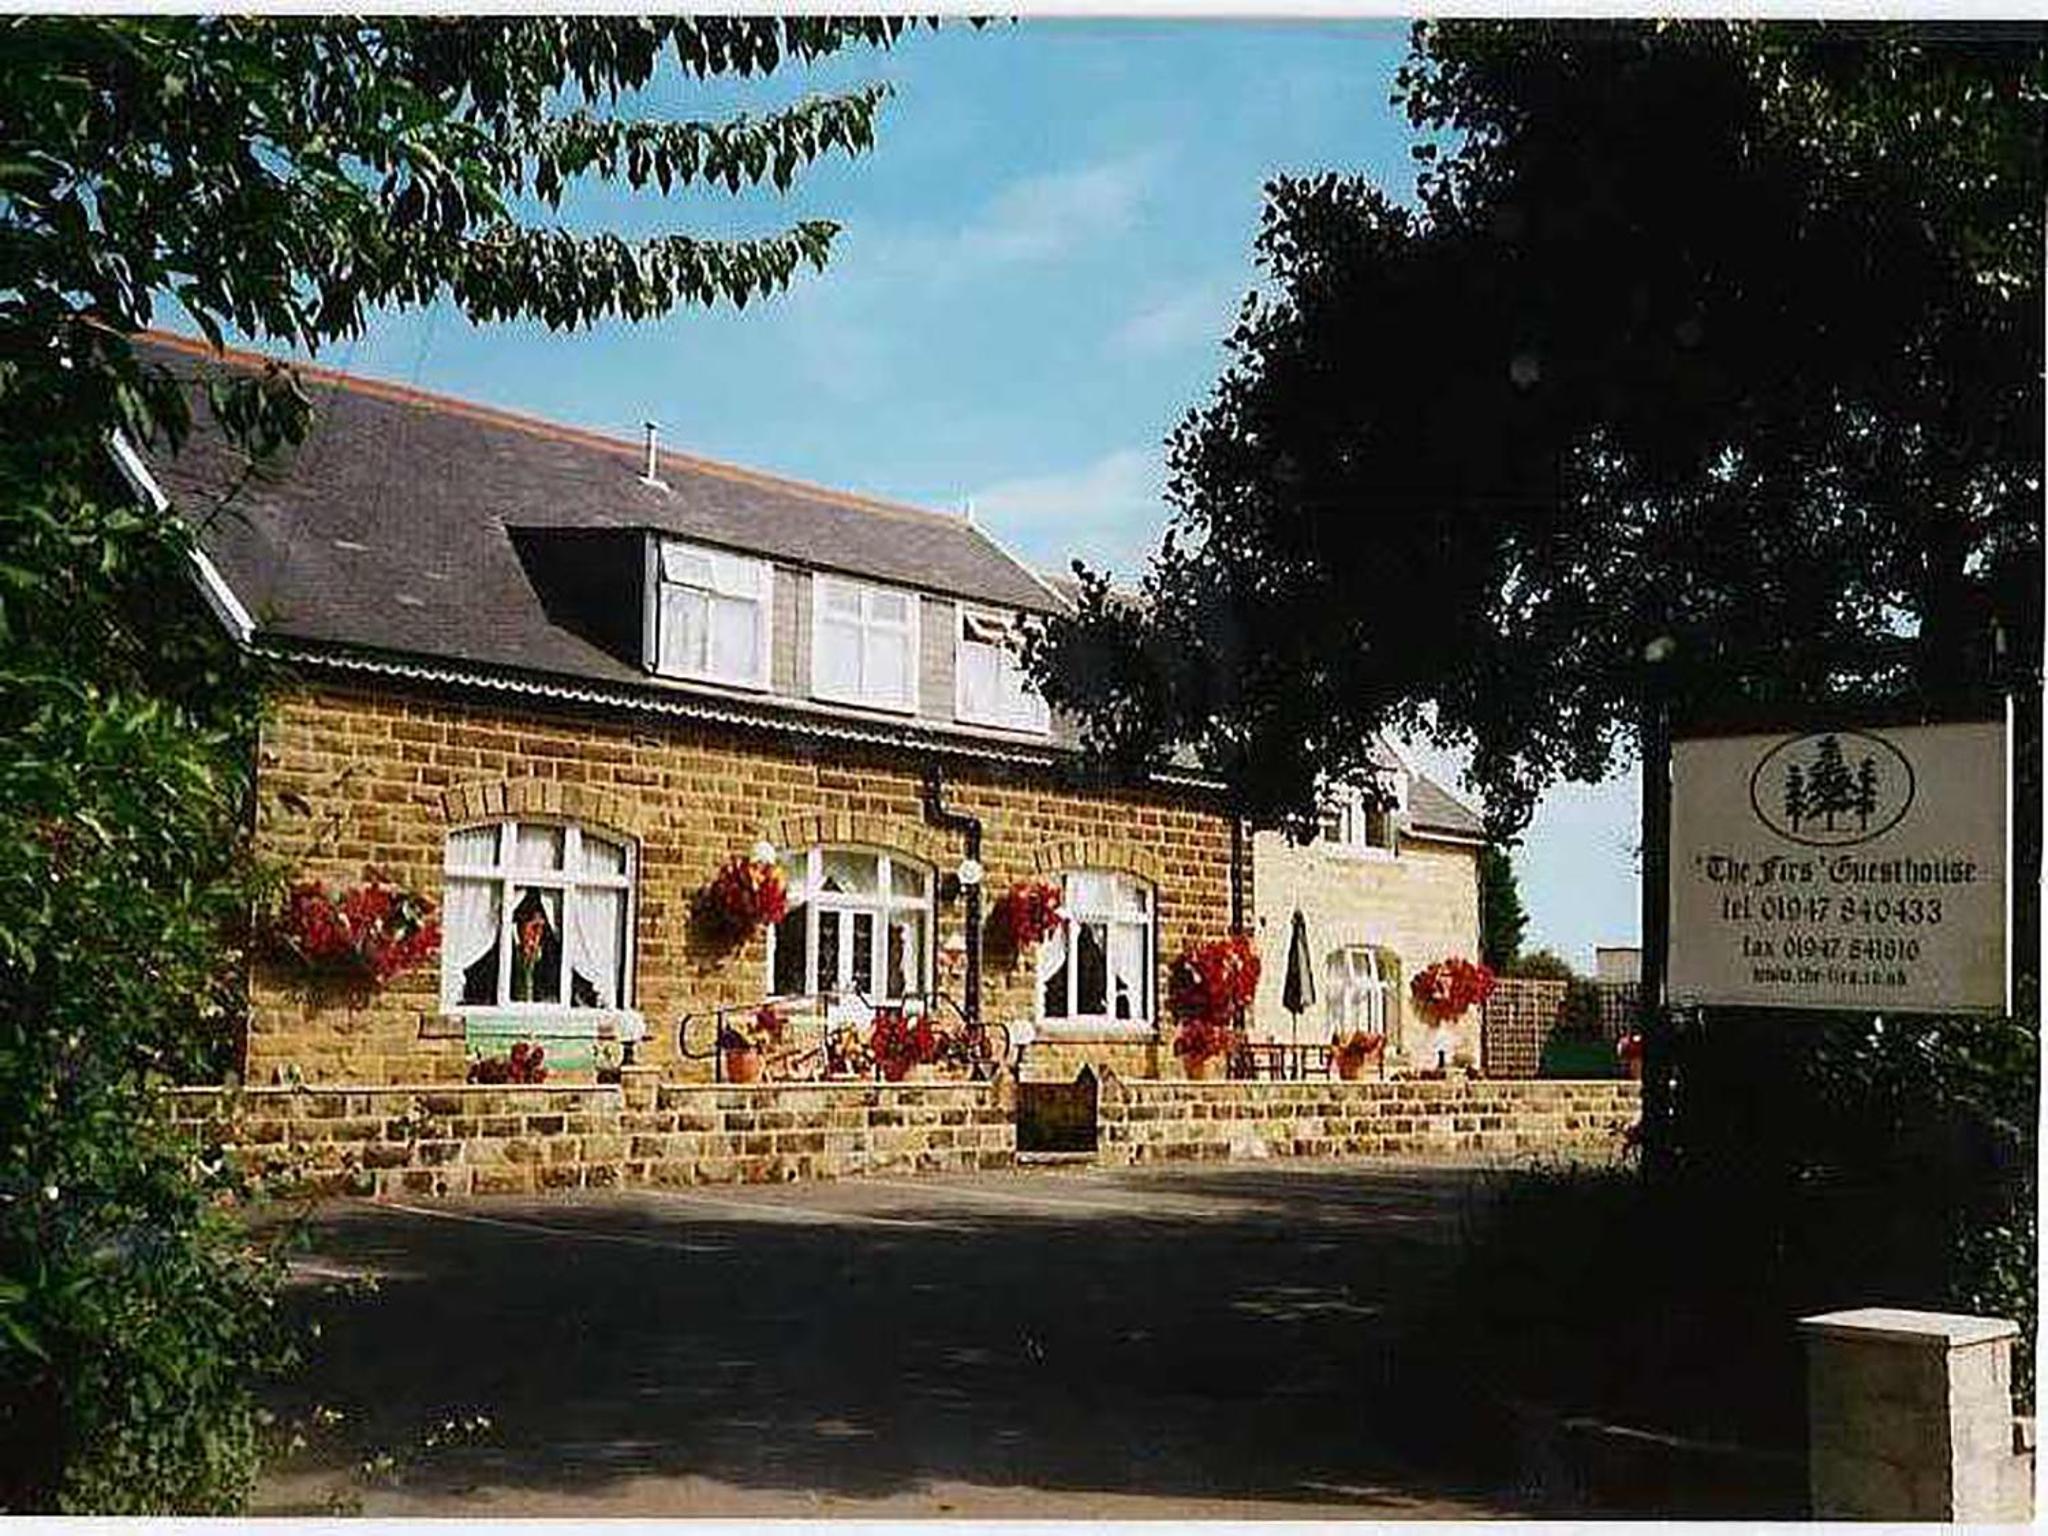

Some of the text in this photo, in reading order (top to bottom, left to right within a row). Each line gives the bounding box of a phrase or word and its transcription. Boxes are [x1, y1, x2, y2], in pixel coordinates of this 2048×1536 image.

[1829, 855, 1978, 884] Guesthouse
[1721, 896, 1942, 924] tel 01947 840433
[1743, 935, 1775, 958] fax
[1784, 937, 1841, 959] 01947
